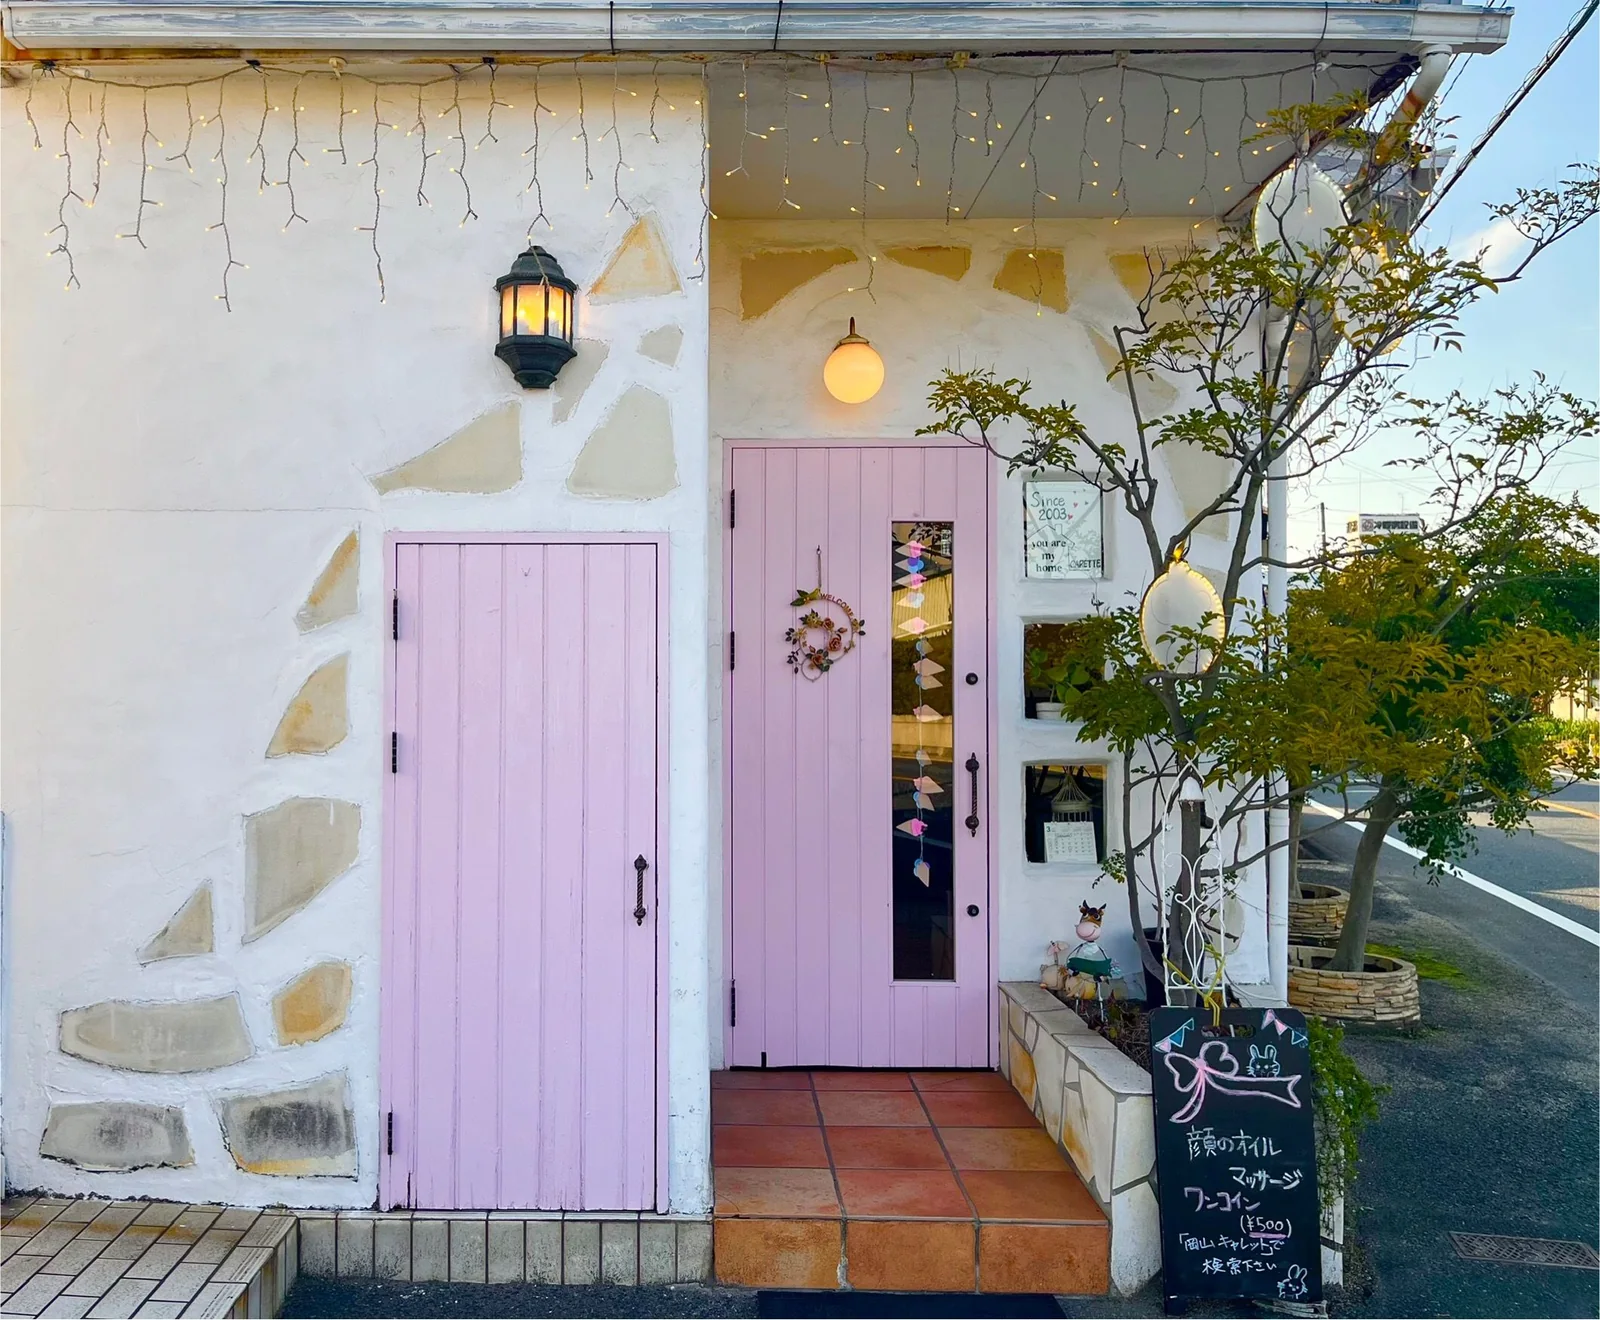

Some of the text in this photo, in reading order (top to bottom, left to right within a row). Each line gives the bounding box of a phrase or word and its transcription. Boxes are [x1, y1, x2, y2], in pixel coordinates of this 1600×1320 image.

[1030, 491, 1066, 508] Since
[1038, 508, 1067, 521] 2003
[1031, 540, 1067, 550] you are
[1041, 552, 1055, 562] my
[1036, 563, 1062, 573] home
[820, 593, 854, 616] WELCOME
[1186, 1124, 1283, 1161] 顔のオイル
[1228, 1166, 1304, 1191] マッサージ
[1184, 1186, 1261, 1212] ワンコイン
[1240, 1214, 1292, 1239] (¥500)
[1202, 1257, 1277, 1275] 検索下さい
